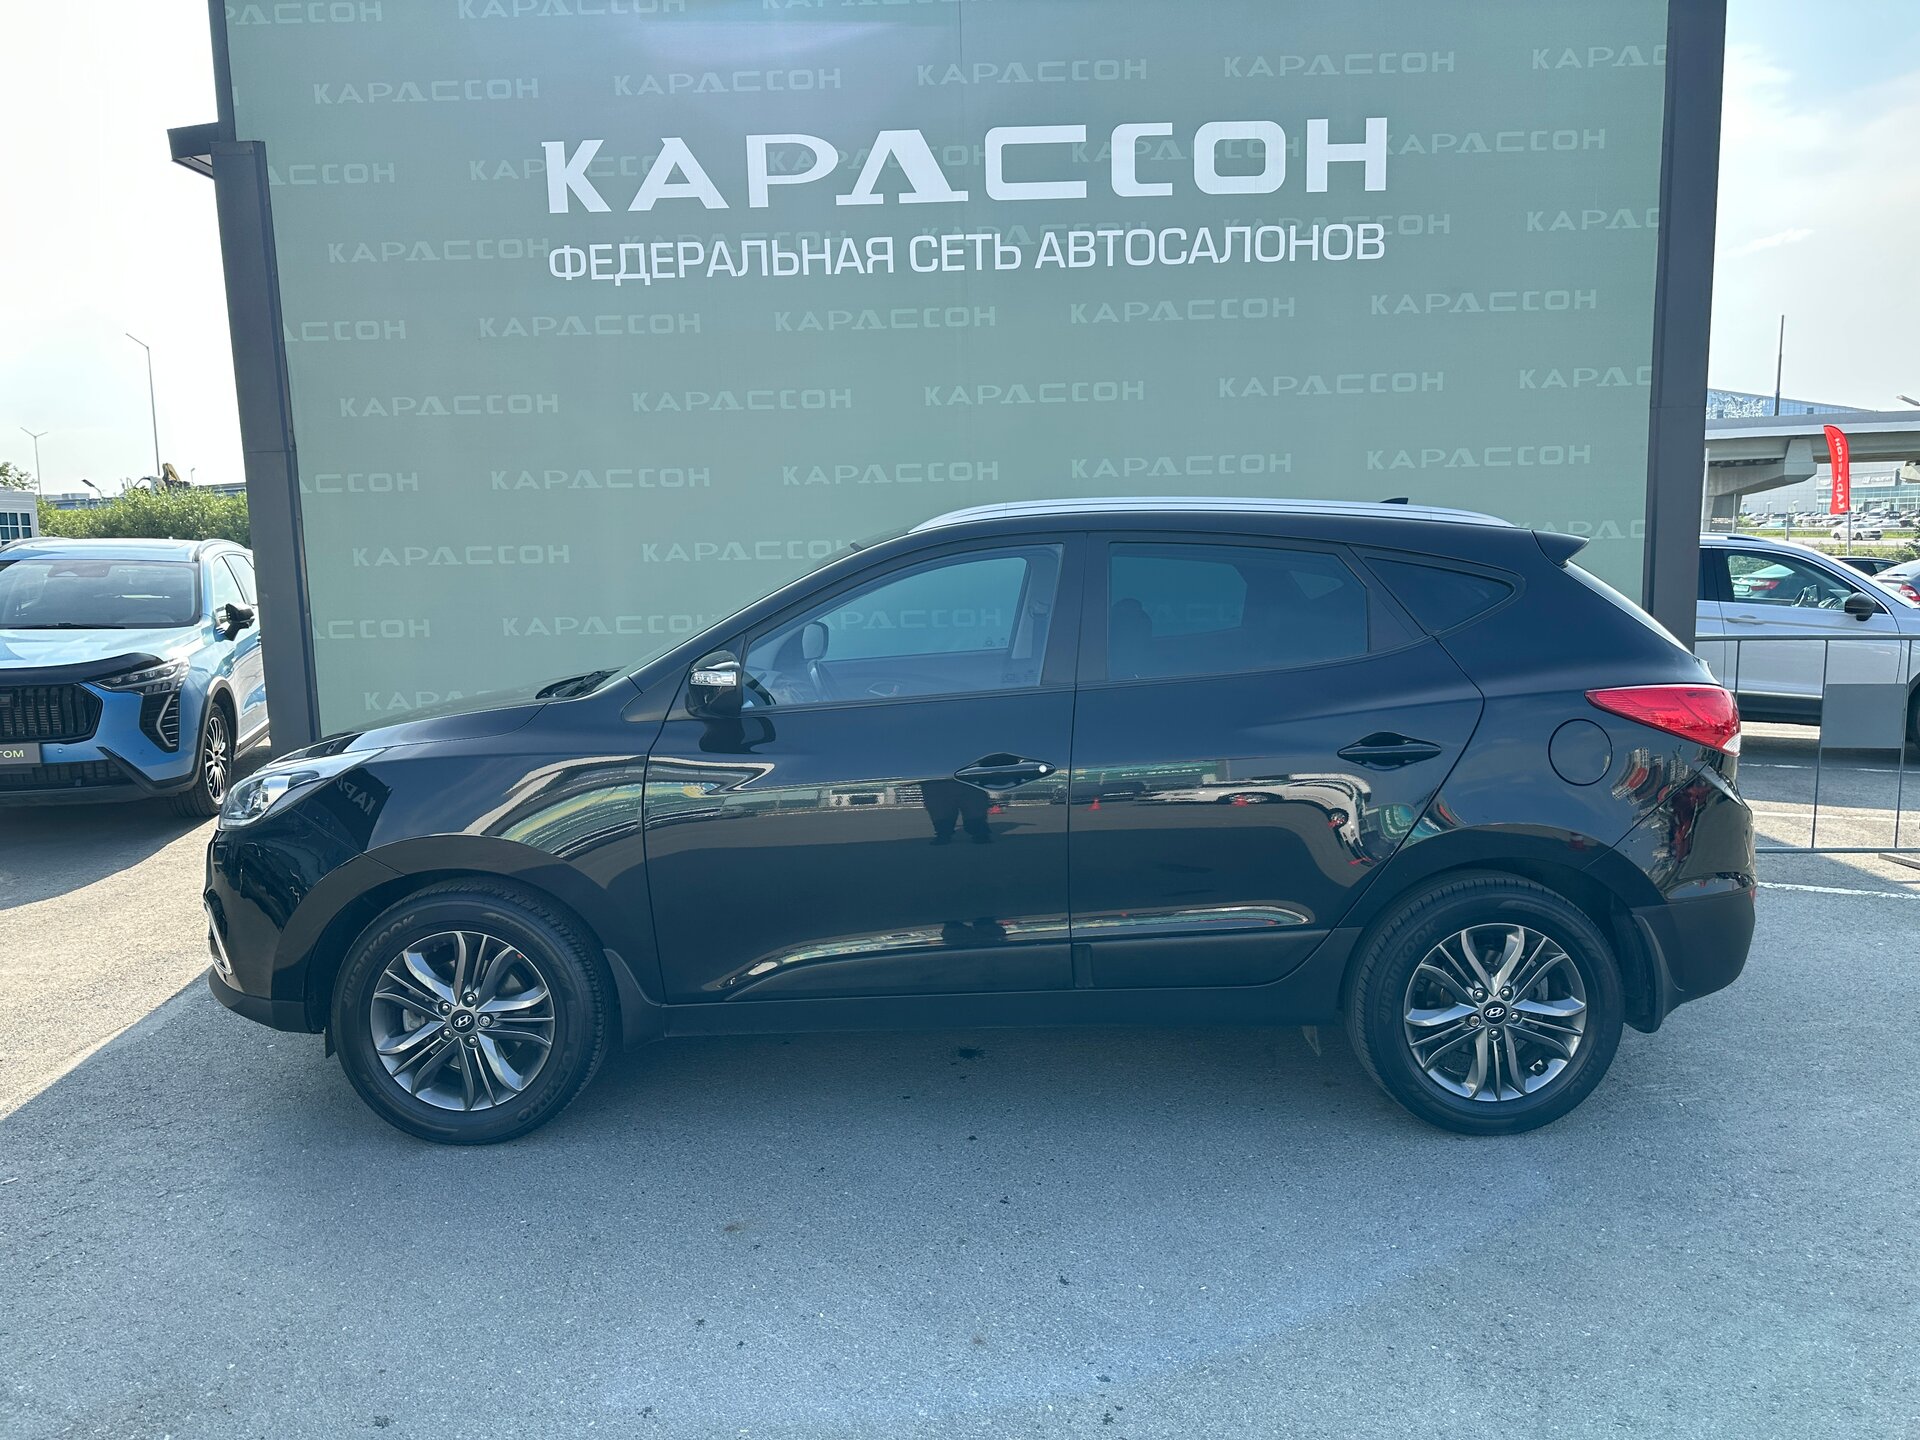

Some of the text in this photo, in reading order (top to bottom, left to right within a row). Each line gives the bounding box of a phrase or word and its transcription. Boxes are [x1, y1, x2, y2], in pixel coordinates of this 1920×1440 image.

[549, 223, 1386, 286] ФЕДЕРАЛЬНАЯ СЕТЬ АВТОСАЛОНОВ
